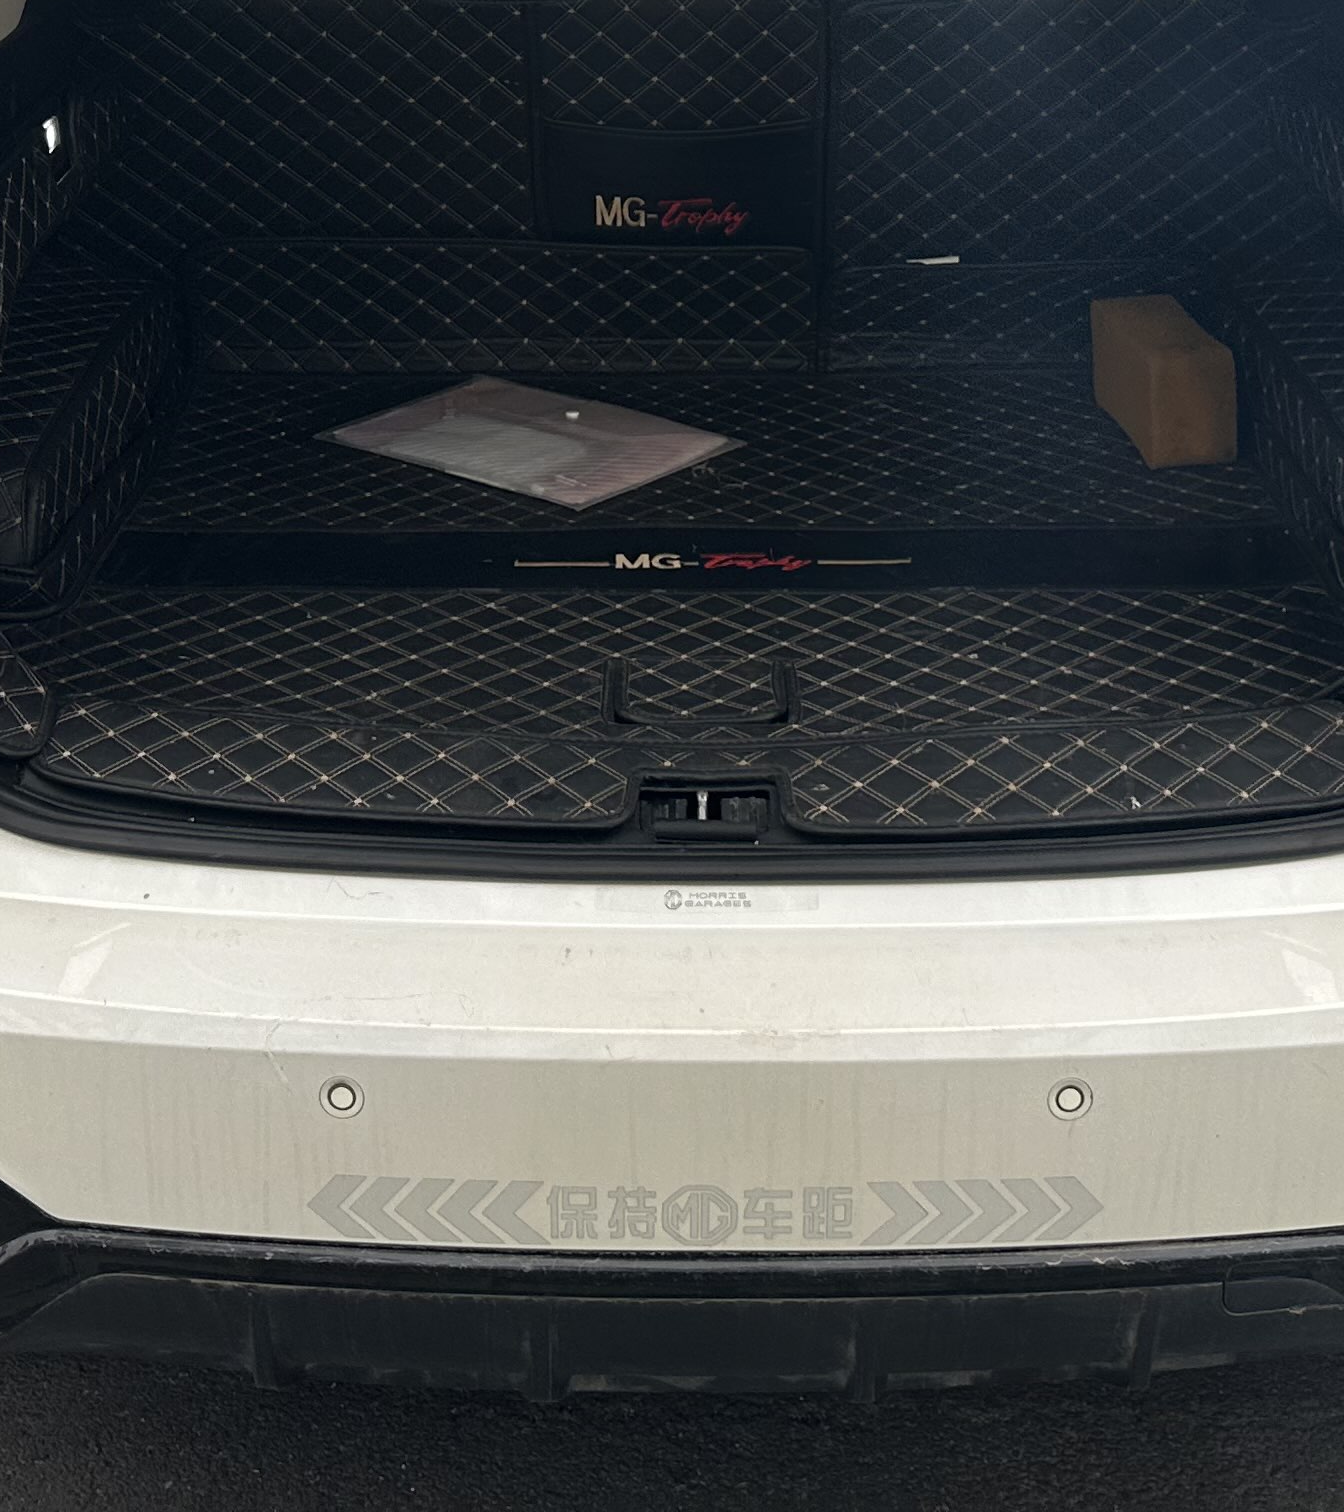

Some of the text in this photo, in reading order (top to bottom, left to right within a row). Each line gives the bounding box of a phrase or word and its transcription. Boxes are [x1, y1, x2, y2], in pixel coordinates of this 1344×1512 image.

[688, 891, 747, 899] MORRIS
[684, 899, 752, 908] GARAGES
[546, 1186, 656, 1239] 保持
[743, 1186, 854, 1239] 车距
